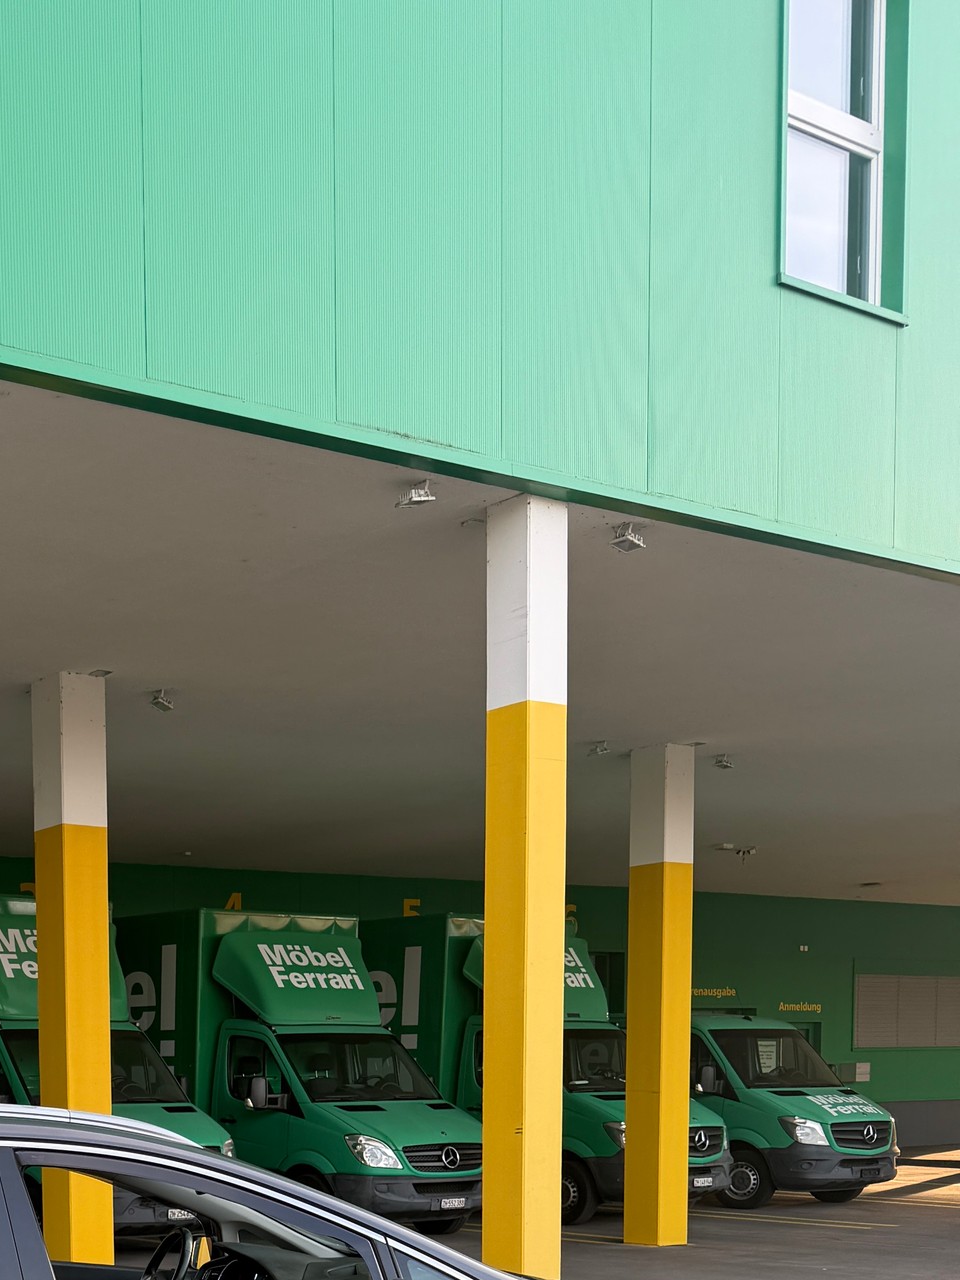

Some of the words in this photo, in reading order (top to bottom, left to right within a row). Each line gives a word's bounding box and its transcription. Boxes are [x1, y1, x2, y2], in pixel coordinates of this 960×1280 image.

[257, 943, 352, 968] Möbel
[268, 966, 365, 990] Ferrari
[691, 986, 736, 998] renausgabe
[778, 1002, 822, 1013] Anmeldung
[806, 1094, 872, 1106] Möbel
[822, 1104, 884, 1117] Ferrari
